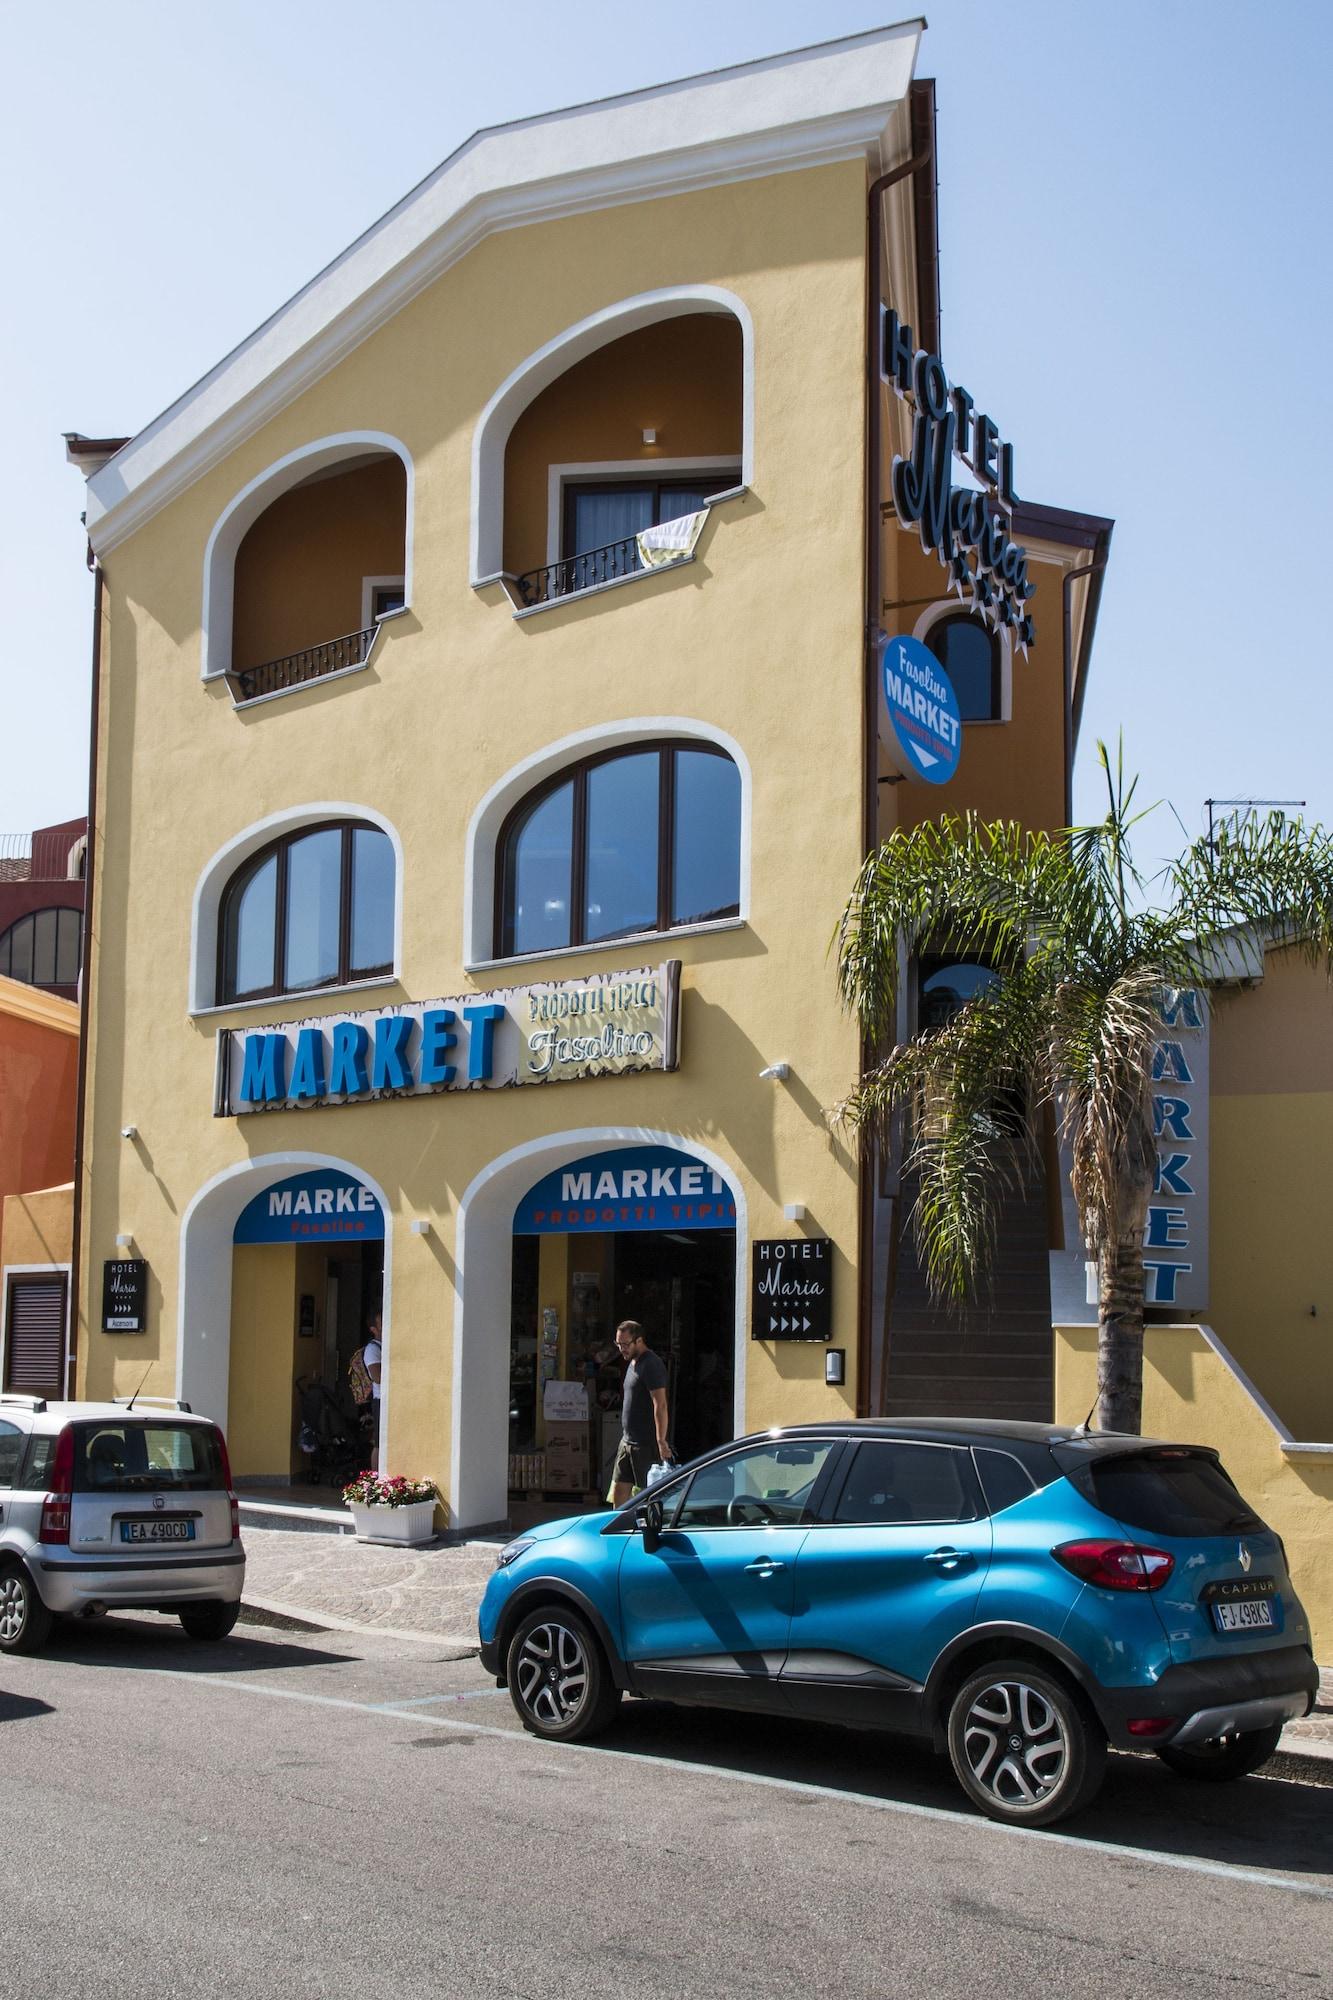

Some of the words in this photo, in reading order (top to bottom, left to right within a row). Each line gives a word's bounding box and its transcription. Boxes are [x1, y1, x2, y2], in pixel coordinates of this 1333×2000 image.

[881, 303, 1019, 514] HOTEL
[892, 410, 1037, 602] Maria
[898, 644, 947, 703] Fasolino
[886, 667, 959, 747] MARKET
[240, 1003, 505, 1102] MARKET
[528, 1022, 655, 1075] Fasolino
[1143, 985, 1205, 1304] MARKET
[268, 1186, 376, 1217] MARKE
[533, 1204, 656, 1225] PRODOTTI
[760, 1243, 823, 1260] HOTEL
[110, 1274, 138, 1293] Maria
[111, 1264, 138, 1273] HOTEL
[758, 1262, 824, 1296] Maria
[130, 1524, 147, 1538] EA
[151, 1523, 188, 1538] 490CD
[1221, 1581, 1274, 1595] CAPTUR
[1219, 1604, 1236, 1628] FJ
[1239, 1602, 1270, 1626] 498KS
